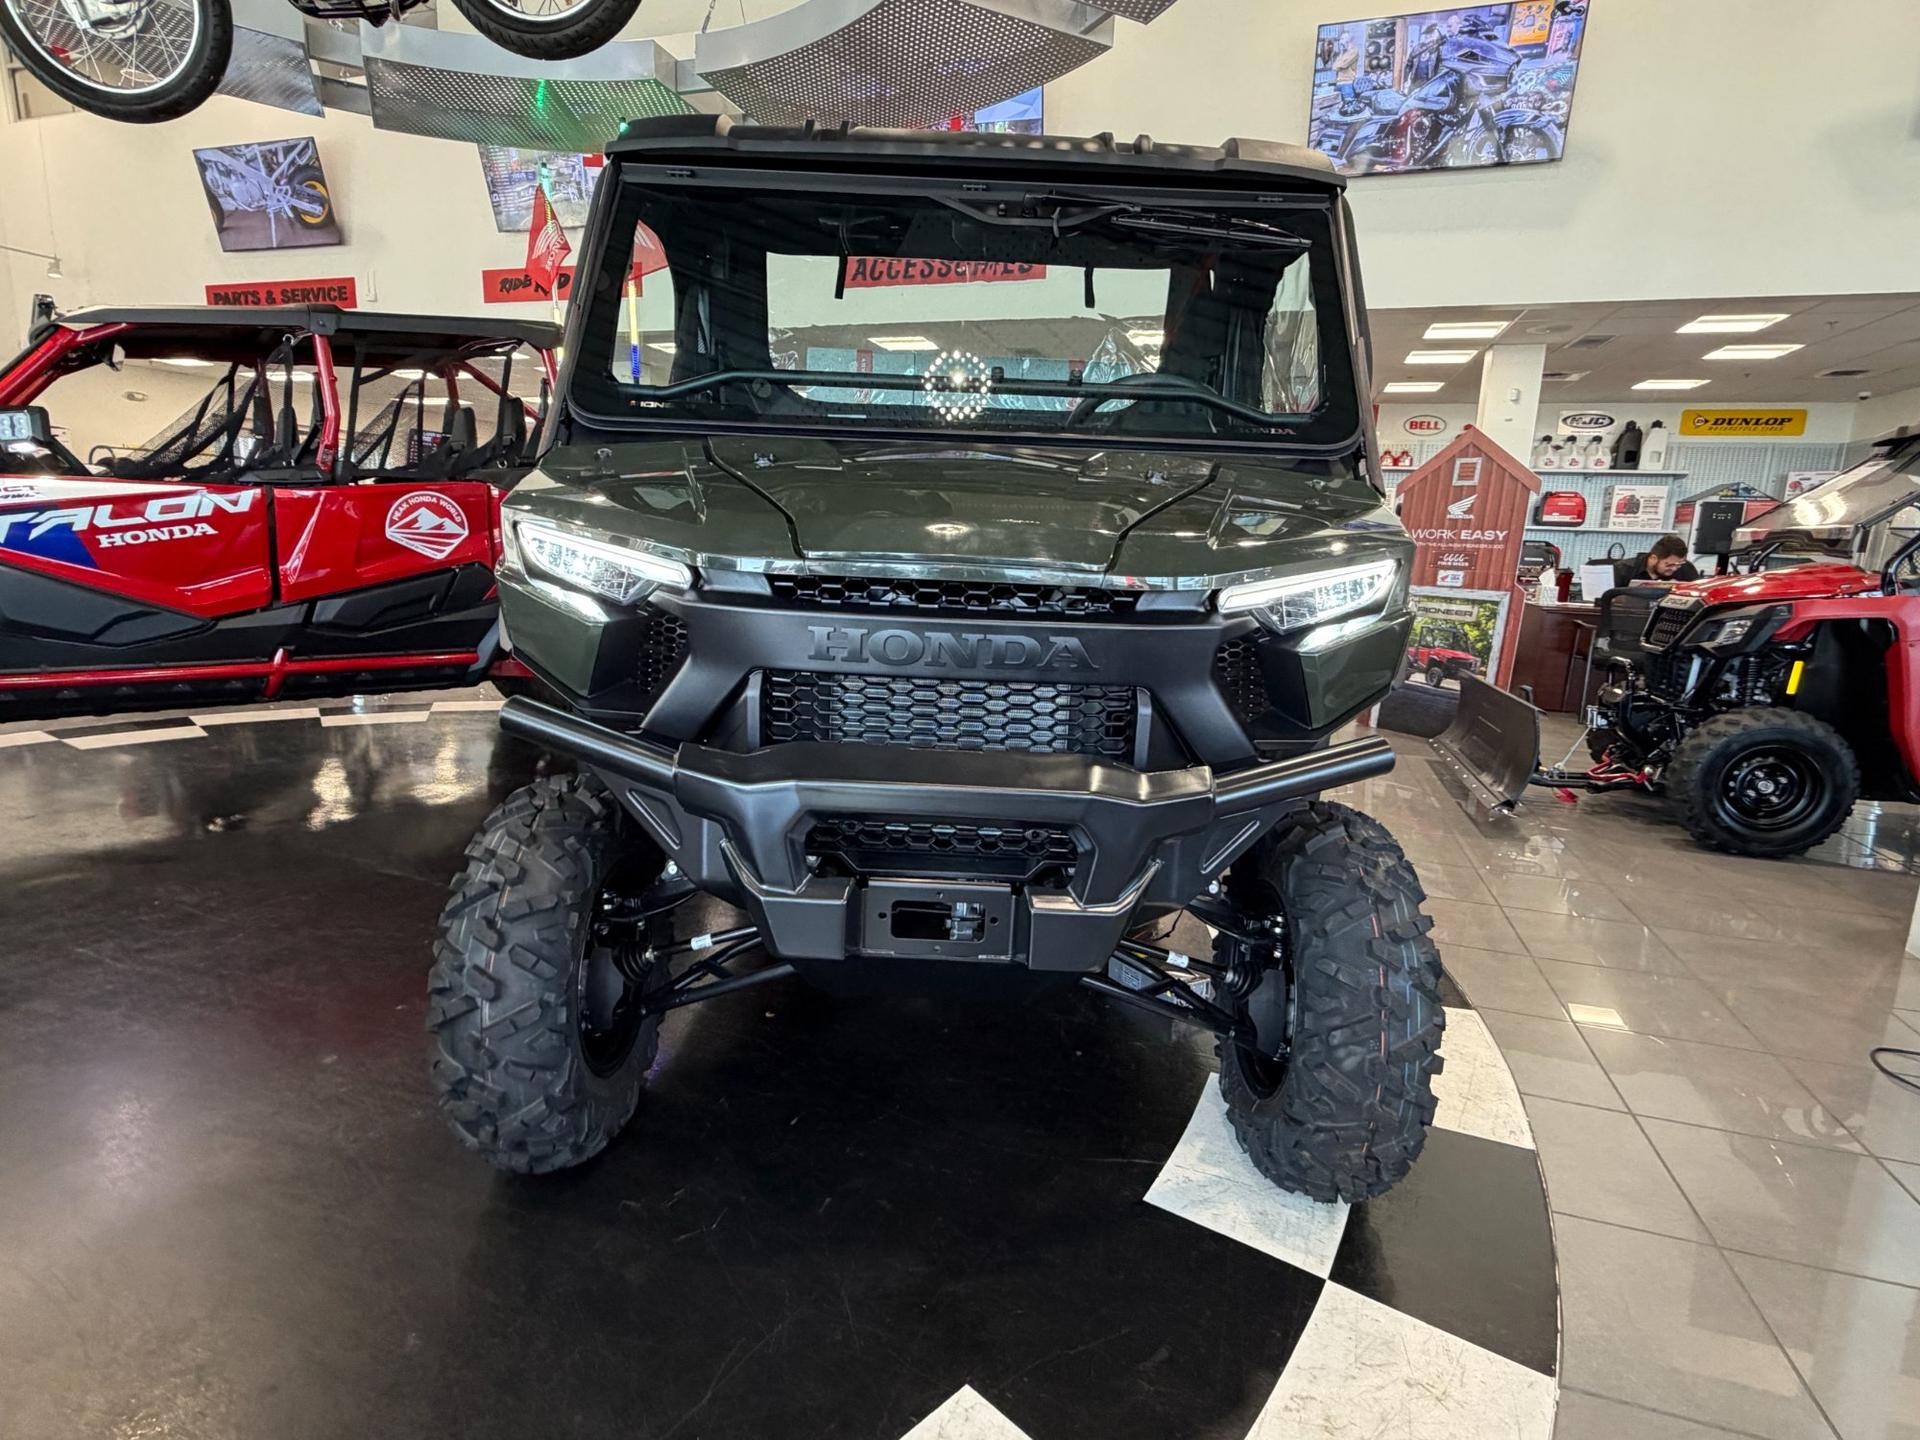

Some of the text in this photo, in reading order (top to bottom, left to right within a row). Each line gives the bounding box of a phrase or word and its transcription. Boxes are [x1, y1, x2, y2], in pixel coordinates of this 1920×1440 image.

[212, 286, 348, 305] PARTS & SERVICE
[1409, 420, 1441, 430] BELL
[1569, 416, 1607, 425] HJC
[1711, 417, 1793, 426] DUNLOP
[392, 495, 462, 523] PEAK HONDA WORLD
[0, 490, 257, 544] TALON
[96, 523, 217, 548] HONDA
[1411, 529, 1508, 540] WORK EASY
[1417, 606, 1473, 617] PIONEER
[807, 625, 1101, 669] HONDA
